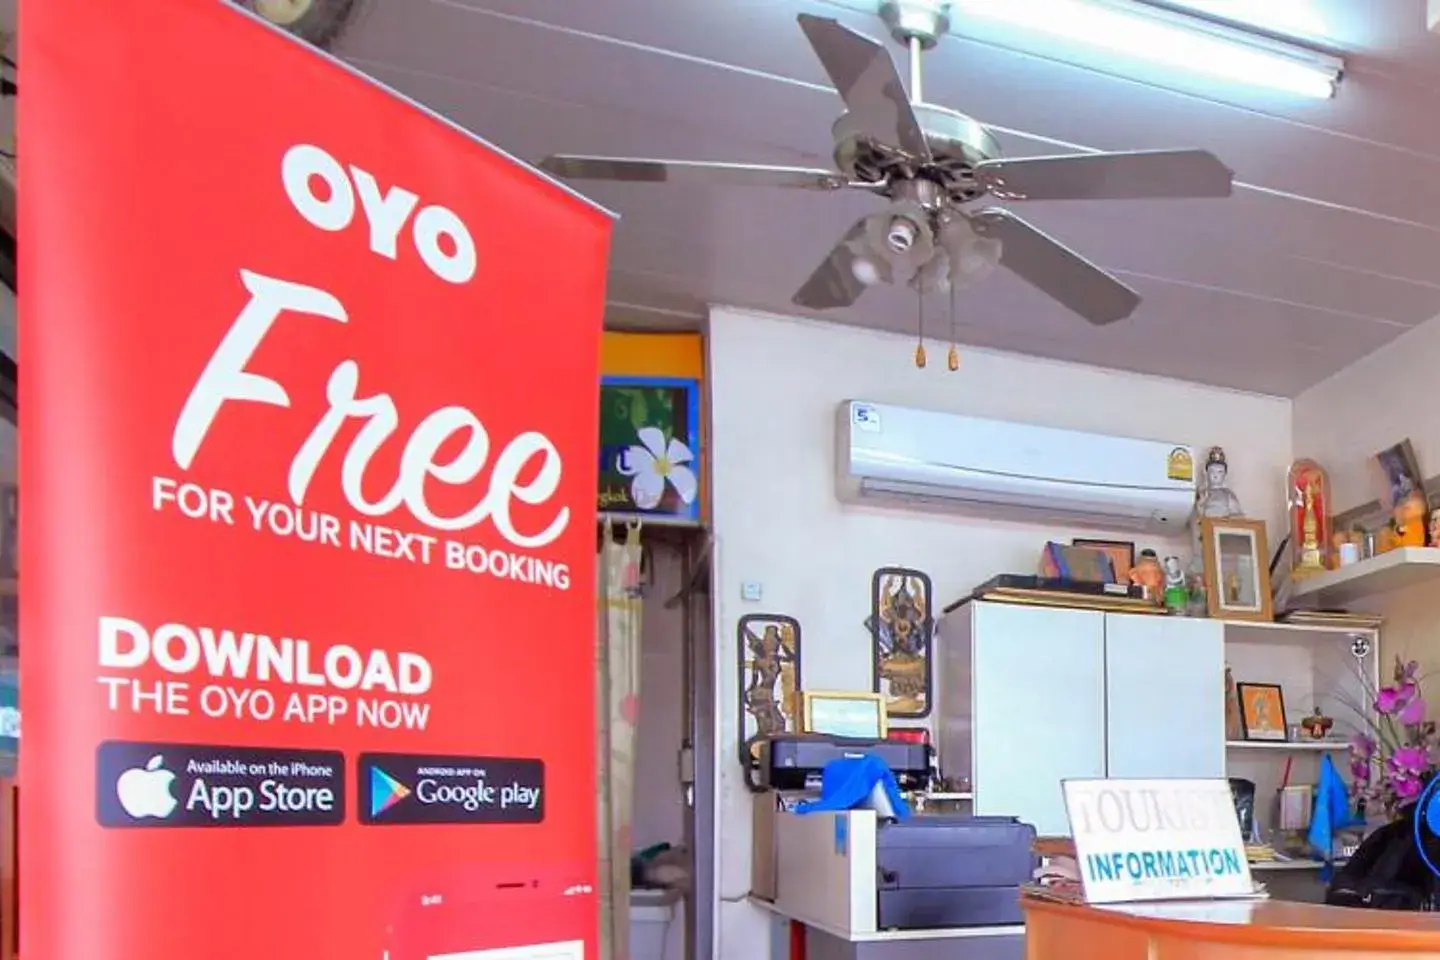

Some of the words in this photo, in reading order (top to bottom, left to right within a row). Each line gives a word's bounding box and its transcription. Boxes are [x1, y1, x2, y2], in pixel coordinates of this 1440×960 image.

[281, 144, 477, 283] OYO
[171, 269, 570, 548] Free
[152, 476, 235, 526] FOR
[244, 496, 342, 548] YOUR
[350, 528, 438, 566] NEXT
[446, 543, 570, 590] BOOKING
[98, 616, 432, 694] DOWNLOAD
[97, 677, 190, 716] THE
[199, 685, 275, 721] OYO
[284, 693, 348, 725] APP
[357, 700, 431, 731] NOW
[187, 760, 247, 775] Available
[249, 764, 266, 775] on
[268, 762, 289, 776] the
[291, 762, 333, 777] iPhone
[417, 779, 495, 811] Google
[501, 782, 540, 809] play
[186, 779, 254, 818] App
[260, 780, 334, 811] Store
[1087, 848, 1242, 883] INFORMATION
